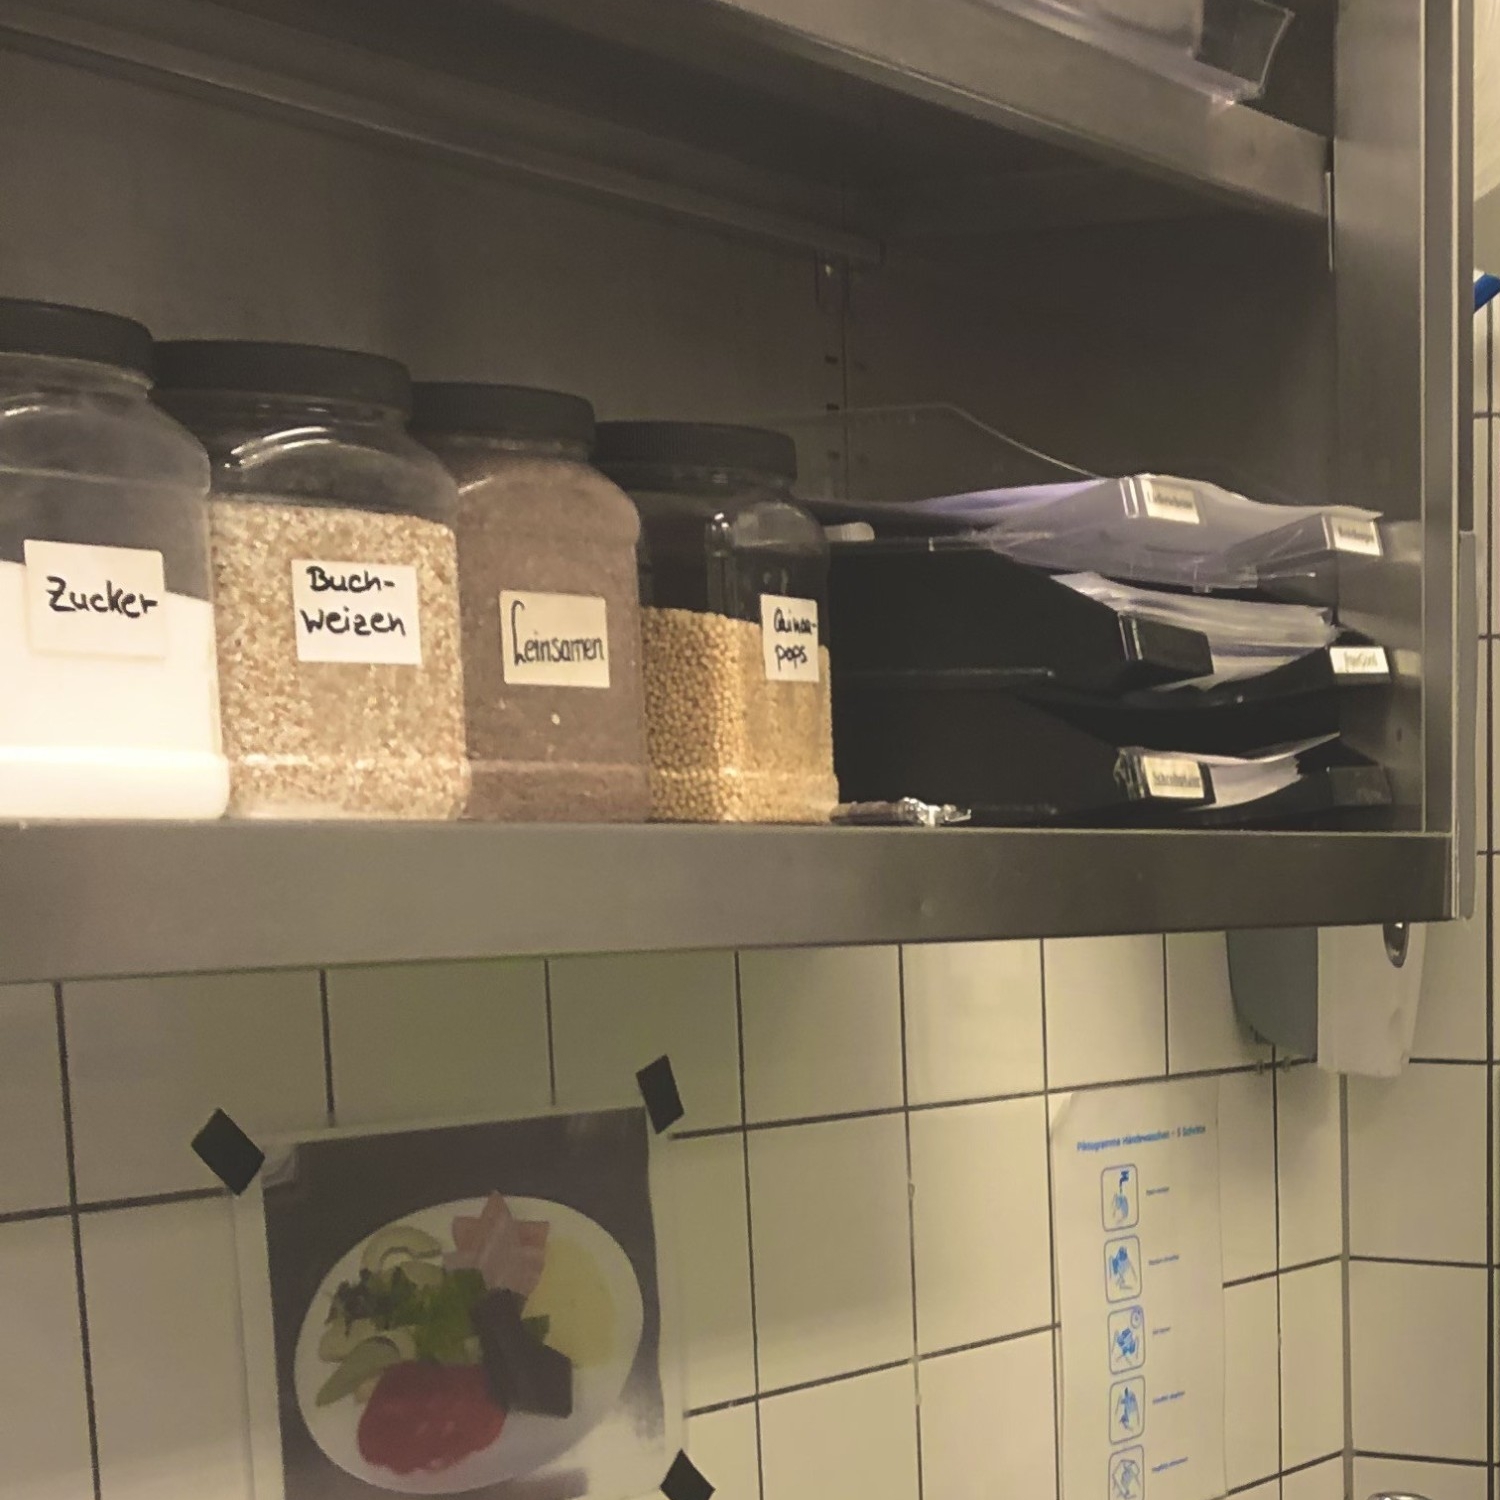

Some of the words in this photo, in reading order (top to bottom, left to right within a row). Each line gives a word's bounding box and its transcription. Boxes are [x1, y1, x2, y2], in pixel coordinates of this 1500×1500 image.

[46, 575, 159, 618] Zucker
[305, 565, 396, 593] Buch-
[510, 599, 605, 666] Leinsamen
